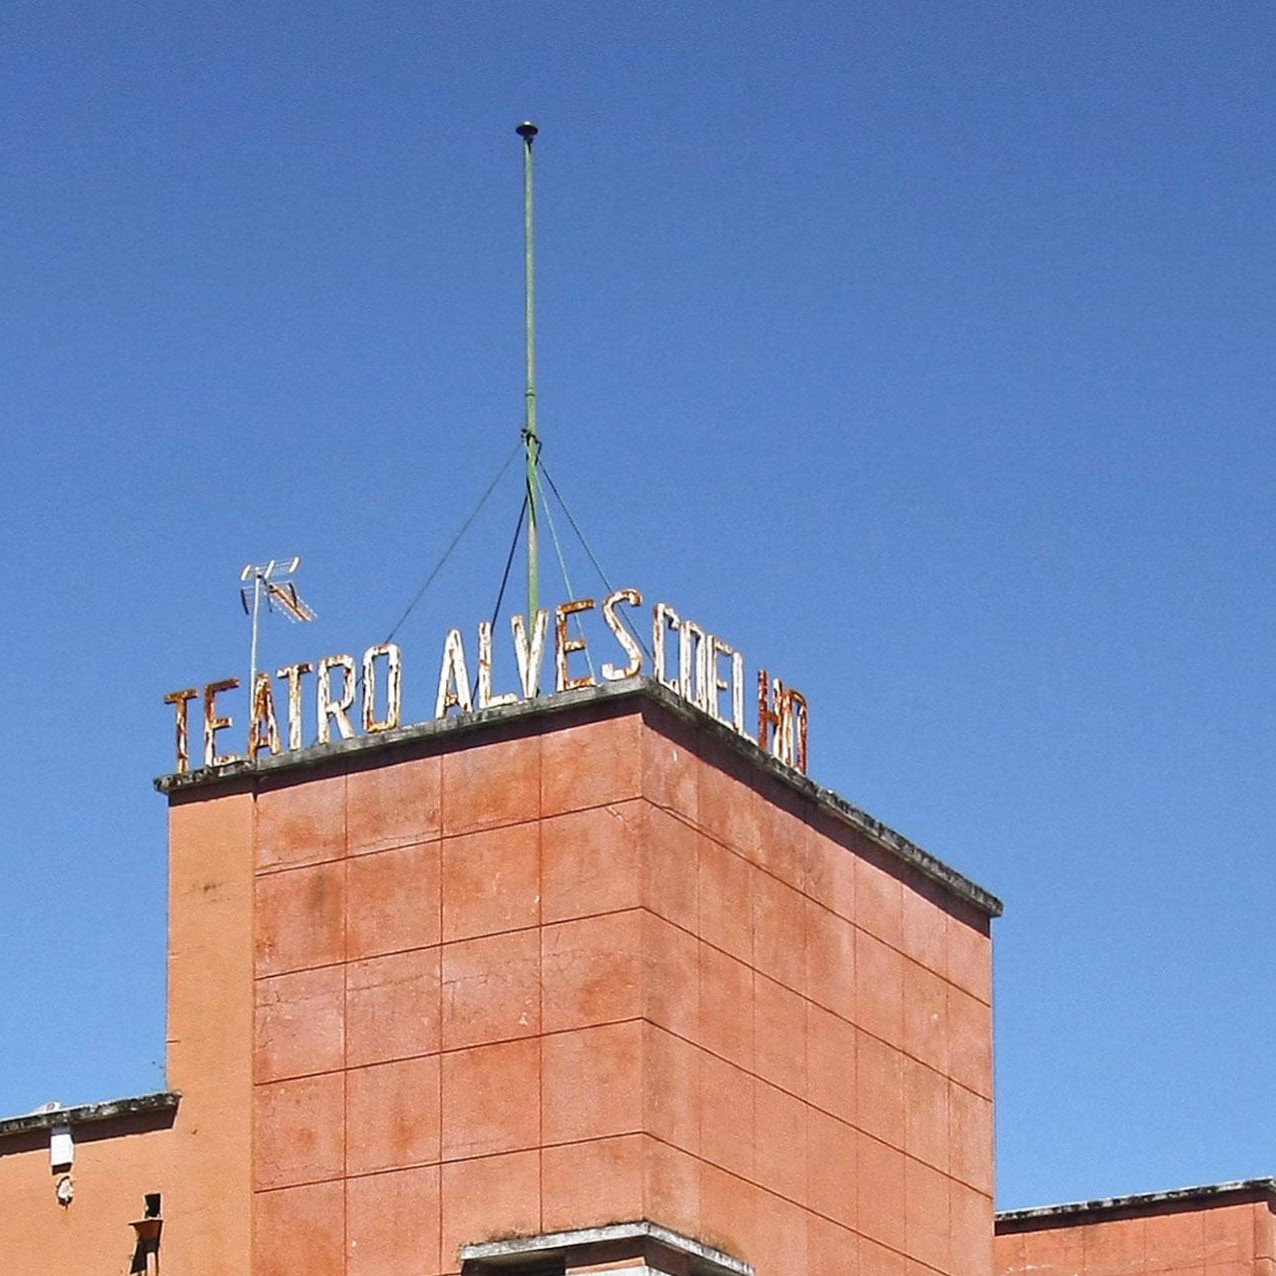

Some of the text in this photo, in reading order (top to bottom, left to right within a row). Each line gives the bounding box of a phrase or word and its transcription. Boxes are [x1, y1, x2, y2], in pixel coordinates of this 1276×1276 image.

[164, 587, 809, 776] TEATRO ALVES COELHO
